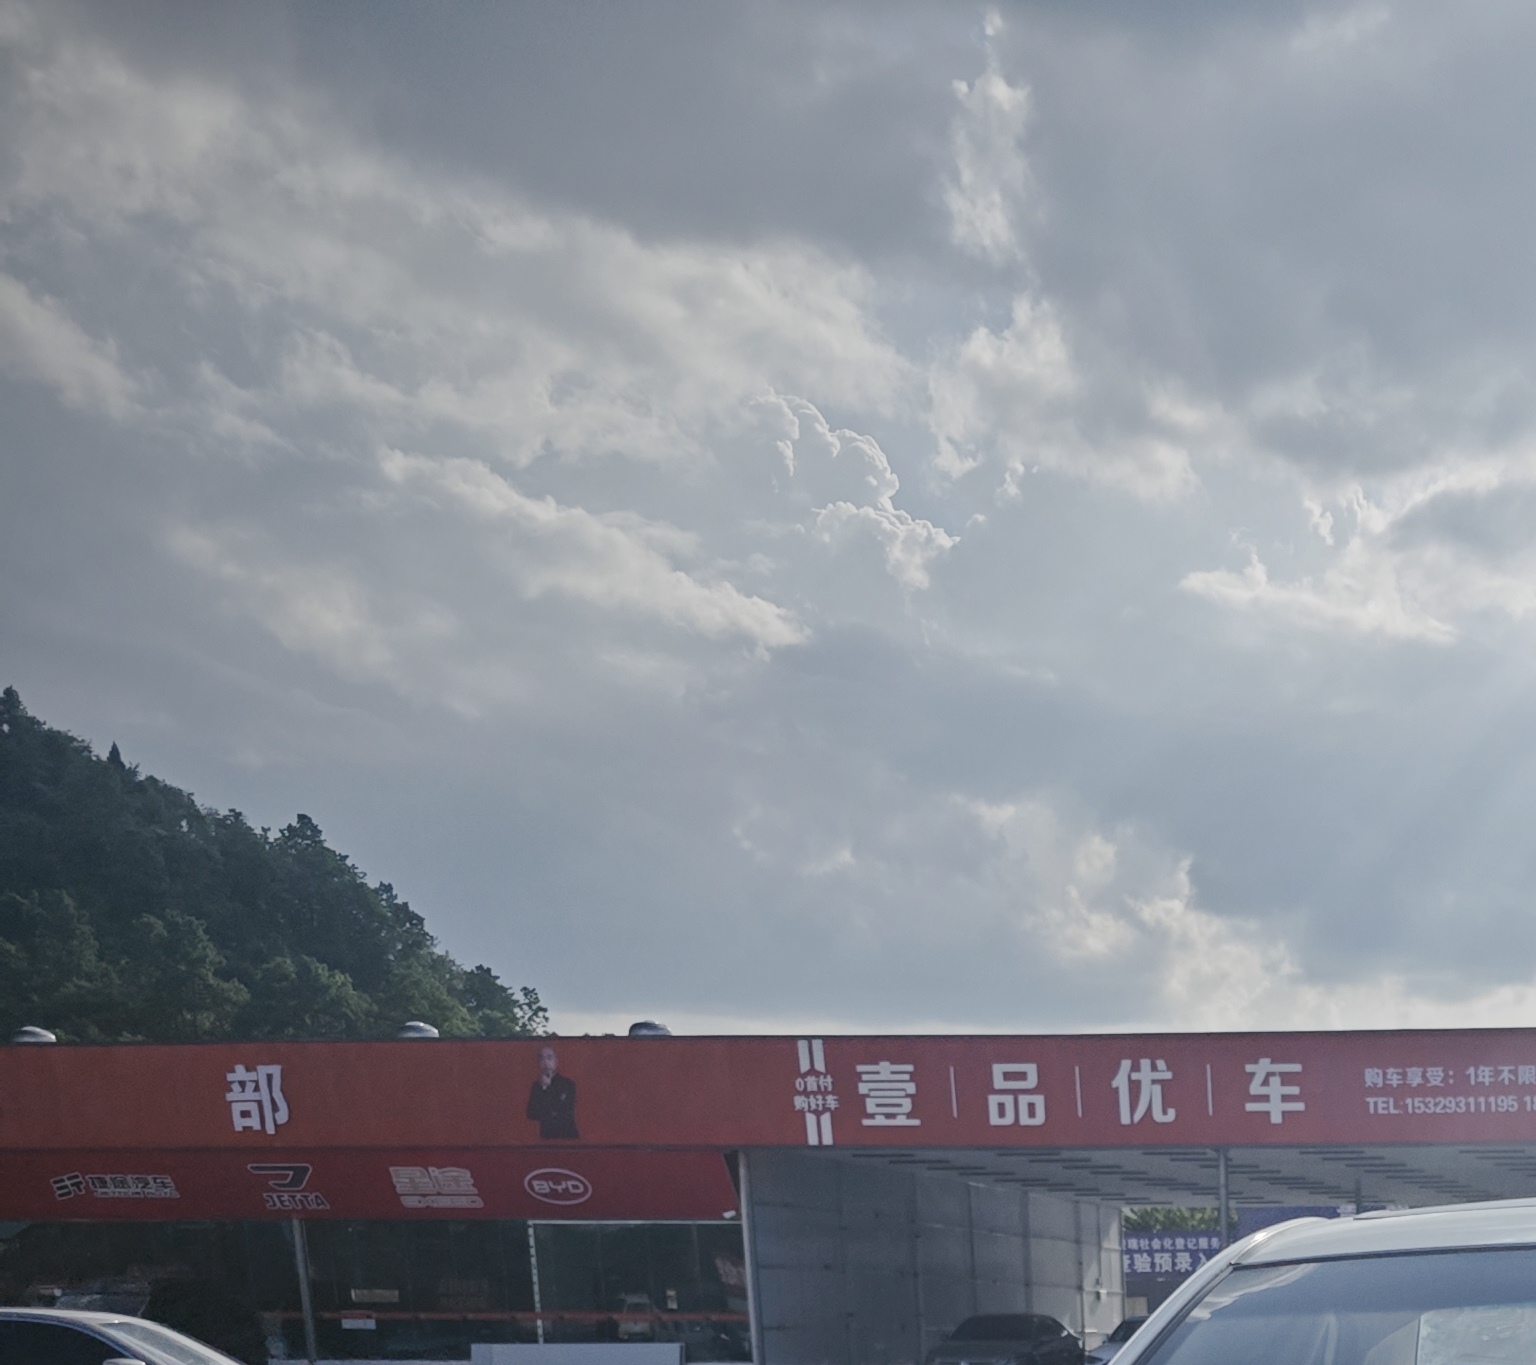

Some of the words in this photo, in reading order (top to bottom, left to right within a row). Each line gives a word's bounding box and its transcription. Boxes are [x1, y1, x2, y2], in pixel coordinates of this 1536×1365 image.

[225, 1064, 290, 1135] 部
[855, 1058, 1306, 1127] 壹品优车
[793, 1094, 840, 1112] 购好车
[532, 1179, 584, 1194] BYD
[264, 1193, 329, 1209] JETTA
